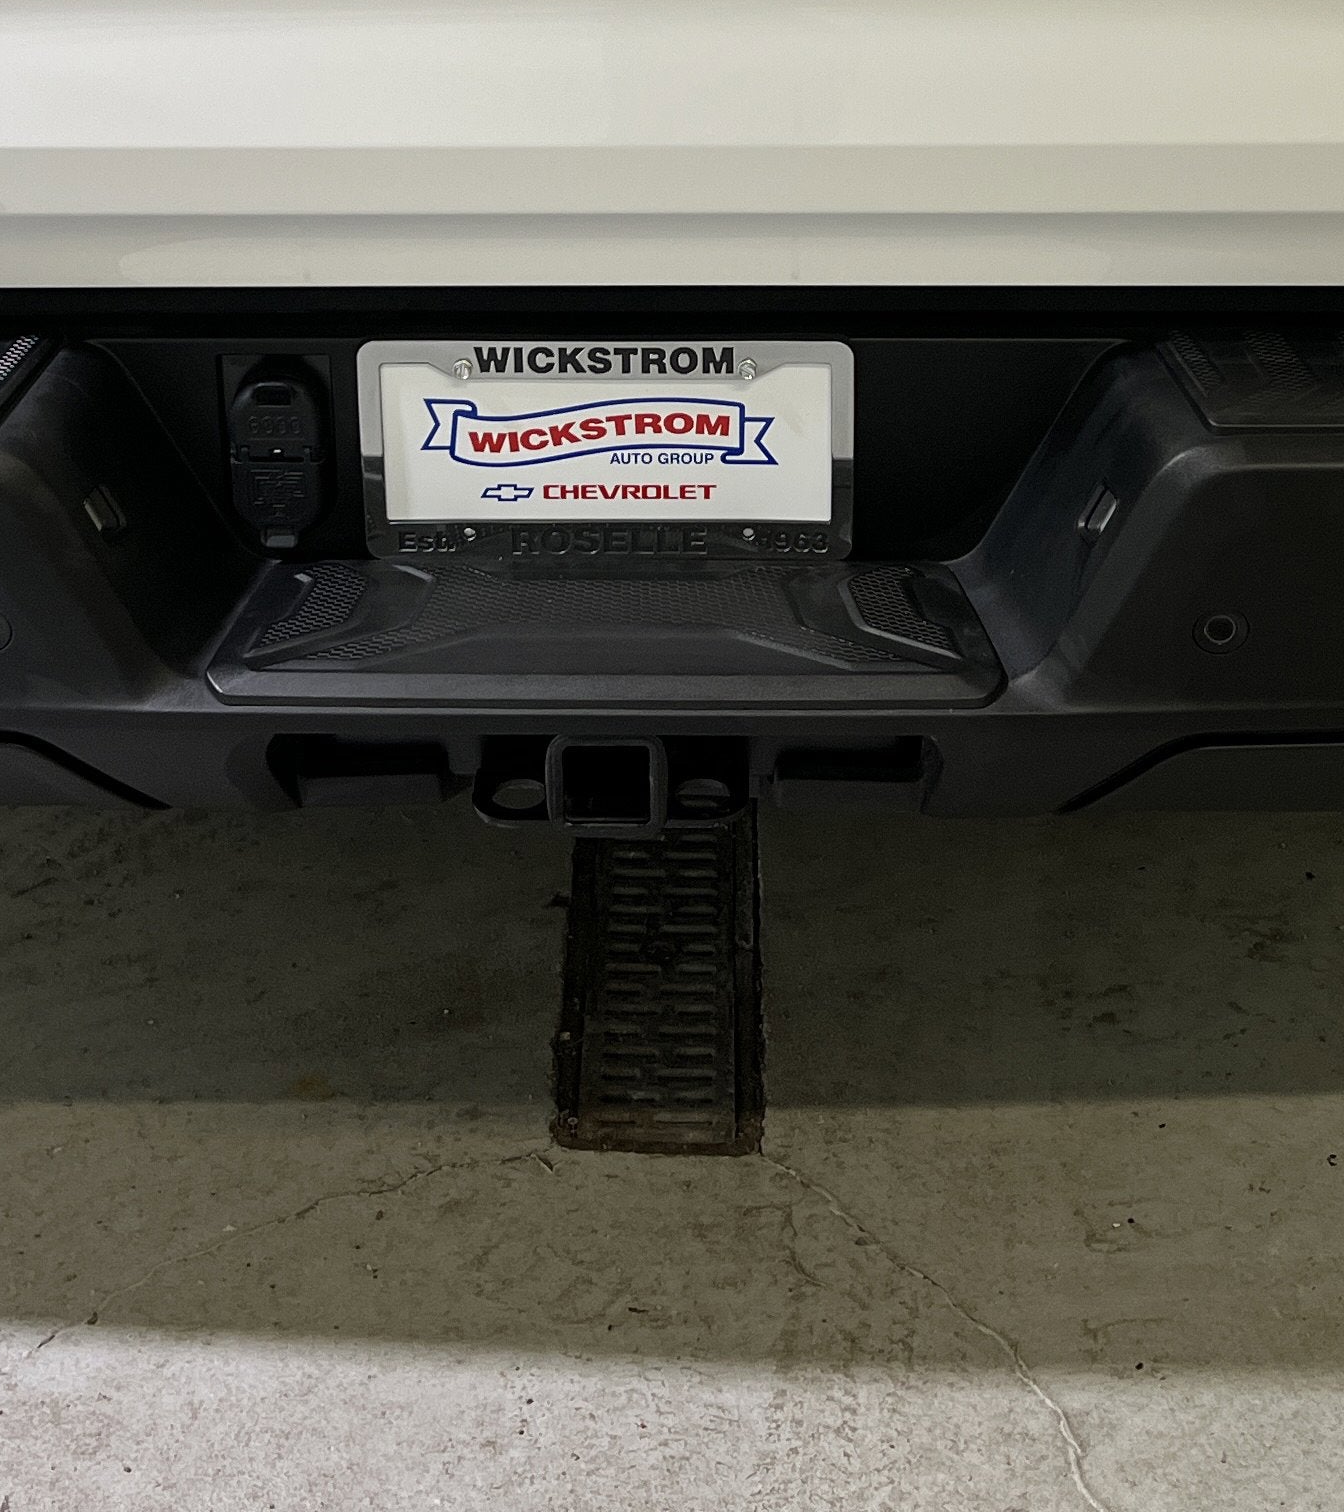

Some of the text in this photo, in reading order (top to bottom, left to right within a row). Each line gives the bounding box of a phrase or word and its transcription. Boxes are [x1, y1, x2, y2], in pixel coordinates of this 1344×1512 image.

[473, 346, 736, 375] WICKSTROM
[468, 412, 731, 454] WICKSTROM
[610, 452, 715, 466] AUTO GROUP
[542, 484, 718, 501] CHEVROLET
[511, 526, 708, 555] ROSELLE
